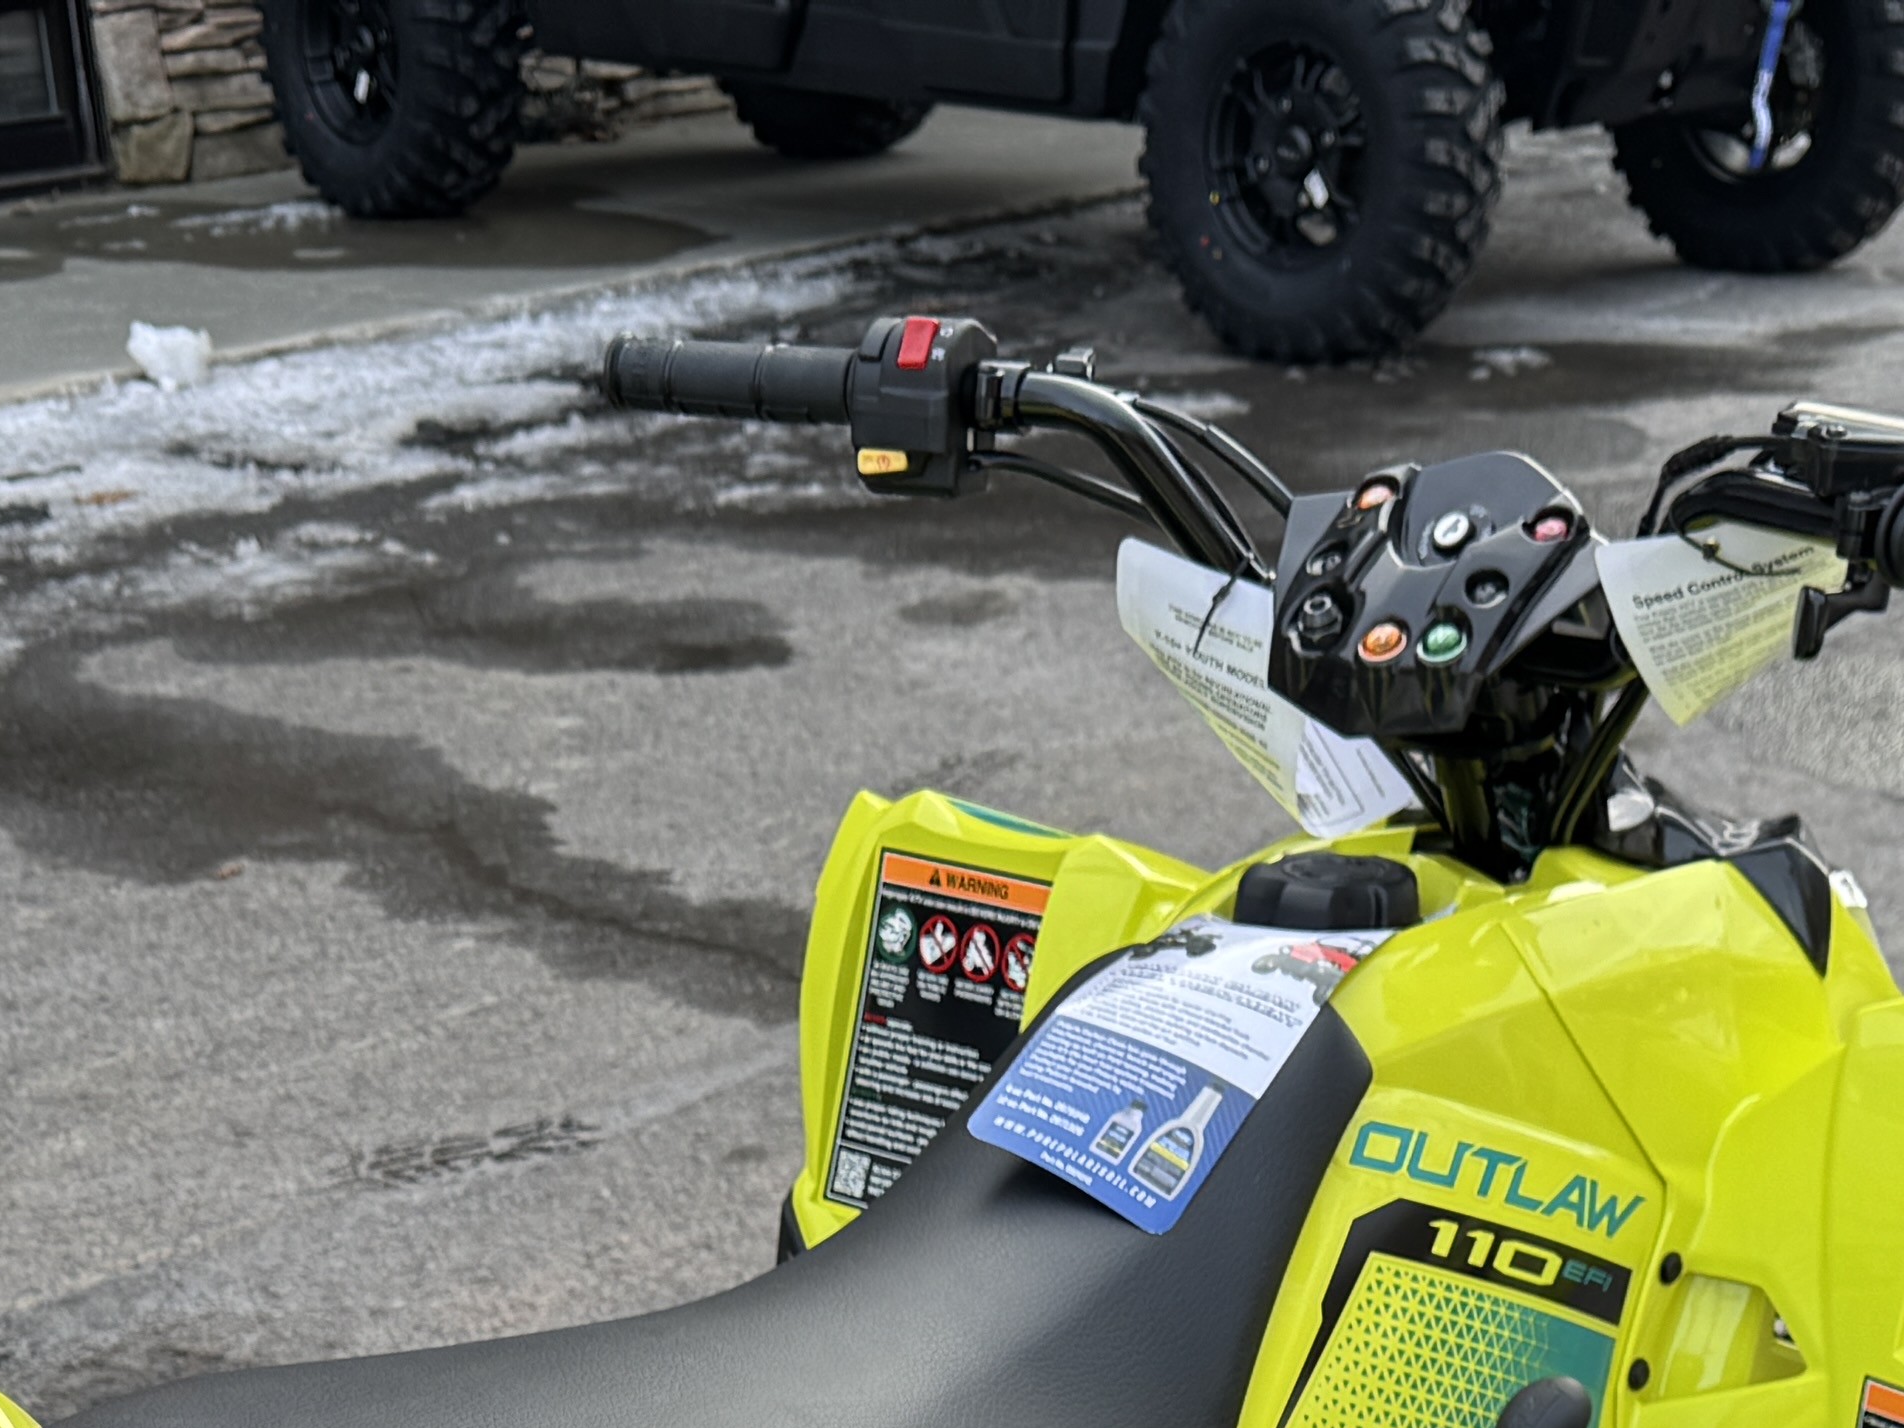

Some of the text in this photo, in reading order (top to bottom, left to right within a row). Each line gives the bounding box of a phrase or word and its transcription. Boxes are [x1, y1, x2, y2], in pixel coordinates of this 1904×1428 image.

[1632, 584, 1684, 609] Speed
[1687, 567, 1749, 596] Contro
[946, 873, 1010, 900] WARNING
[1349, 1120, 1646, 1238] OUTLAW
[1428, 1219, 1614, 1293] 110 EFI
